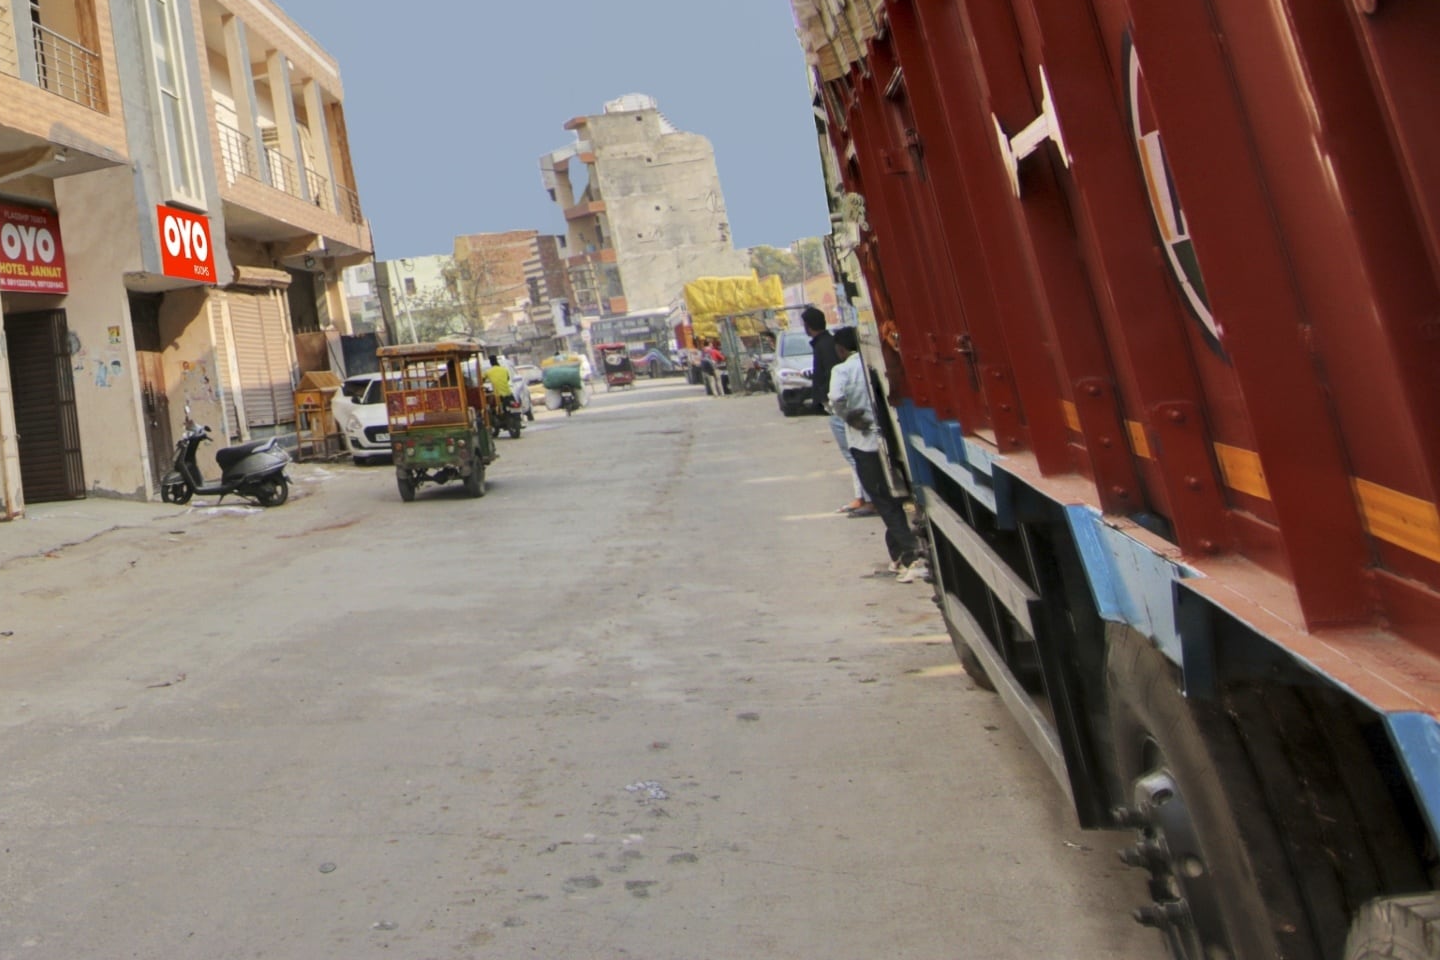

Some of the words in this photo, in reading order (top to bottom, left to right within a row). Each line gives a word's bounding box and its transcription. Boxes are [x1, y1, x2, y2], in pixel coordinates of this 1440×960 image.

[1, 222, 55, 263] OYO
[164, 215, 208, 262] OYO
[0, 262, 29, 276] HOTEL
[31, 265, 62, 278] JANNAT
